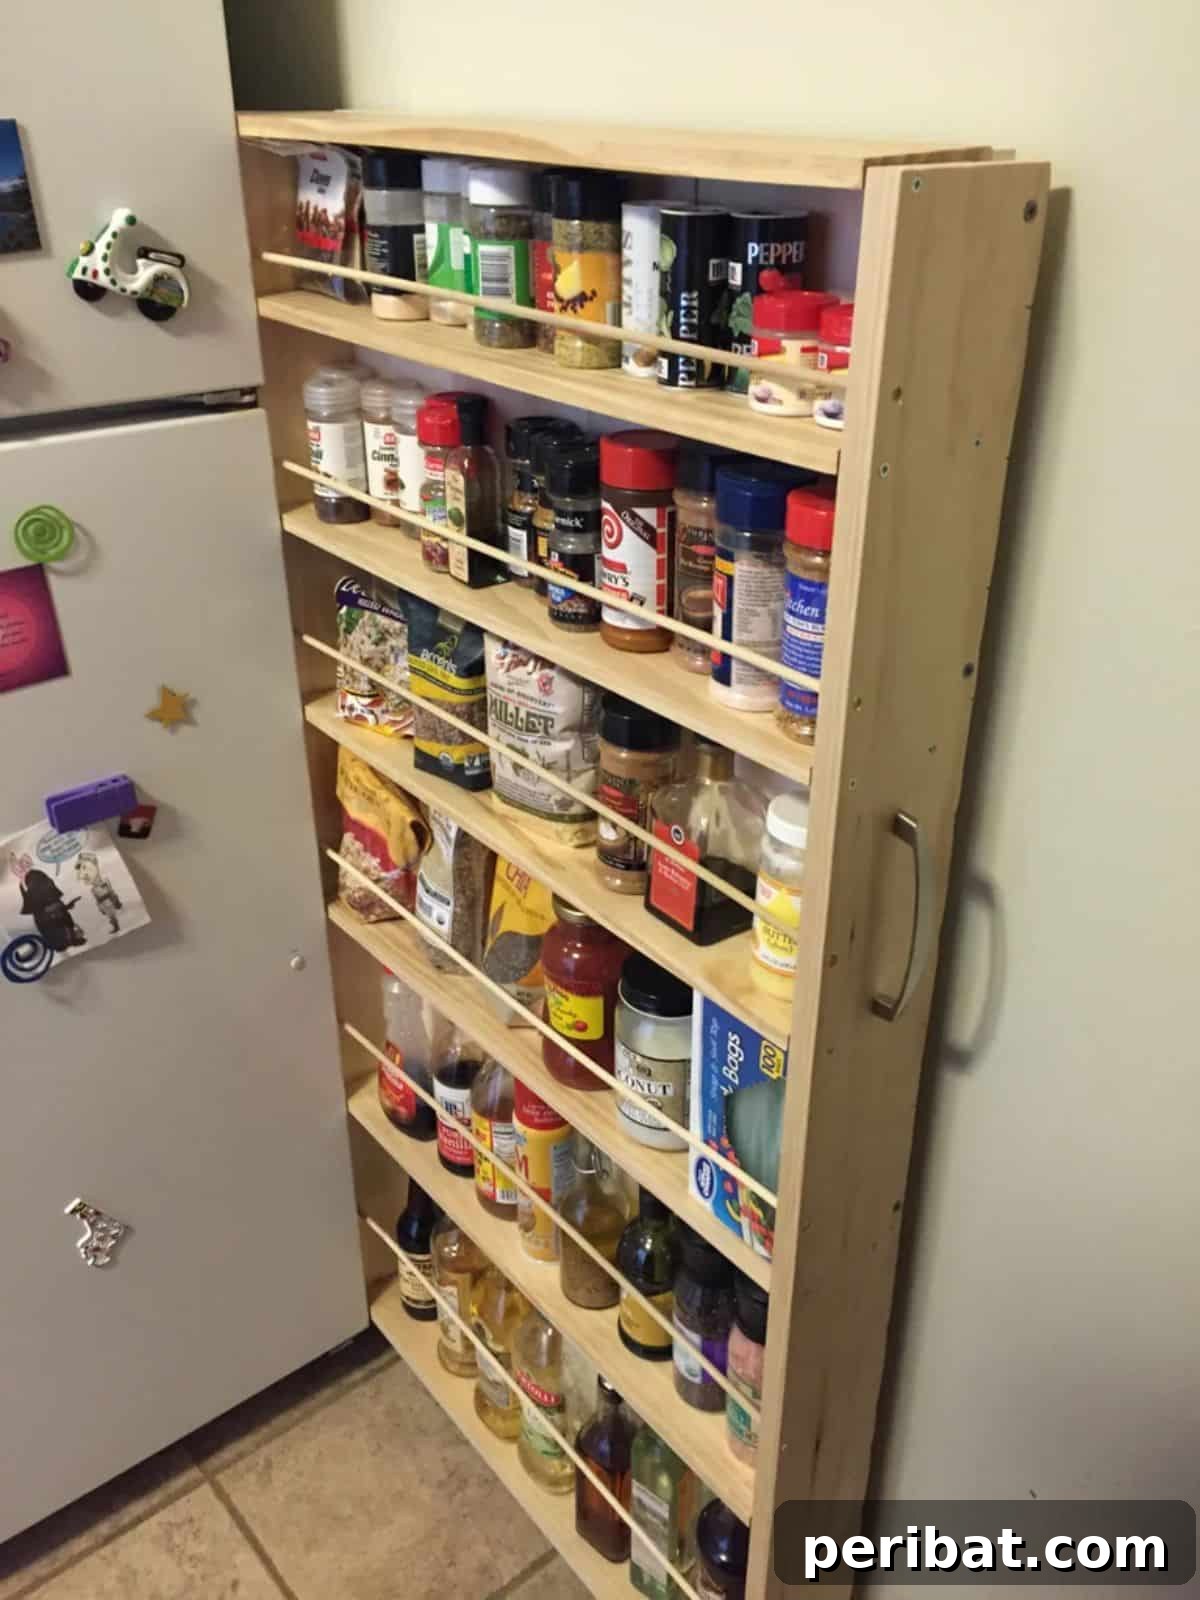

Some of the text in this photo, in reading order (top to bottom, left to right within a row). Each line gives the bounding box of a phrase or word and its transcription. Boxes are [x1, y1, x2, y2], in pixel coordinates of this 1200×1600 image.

[678, 290, 699, 387] PEPER
[722, 1031, 744, 1086] Bags
[761, 1044, 777, 1075] 100
